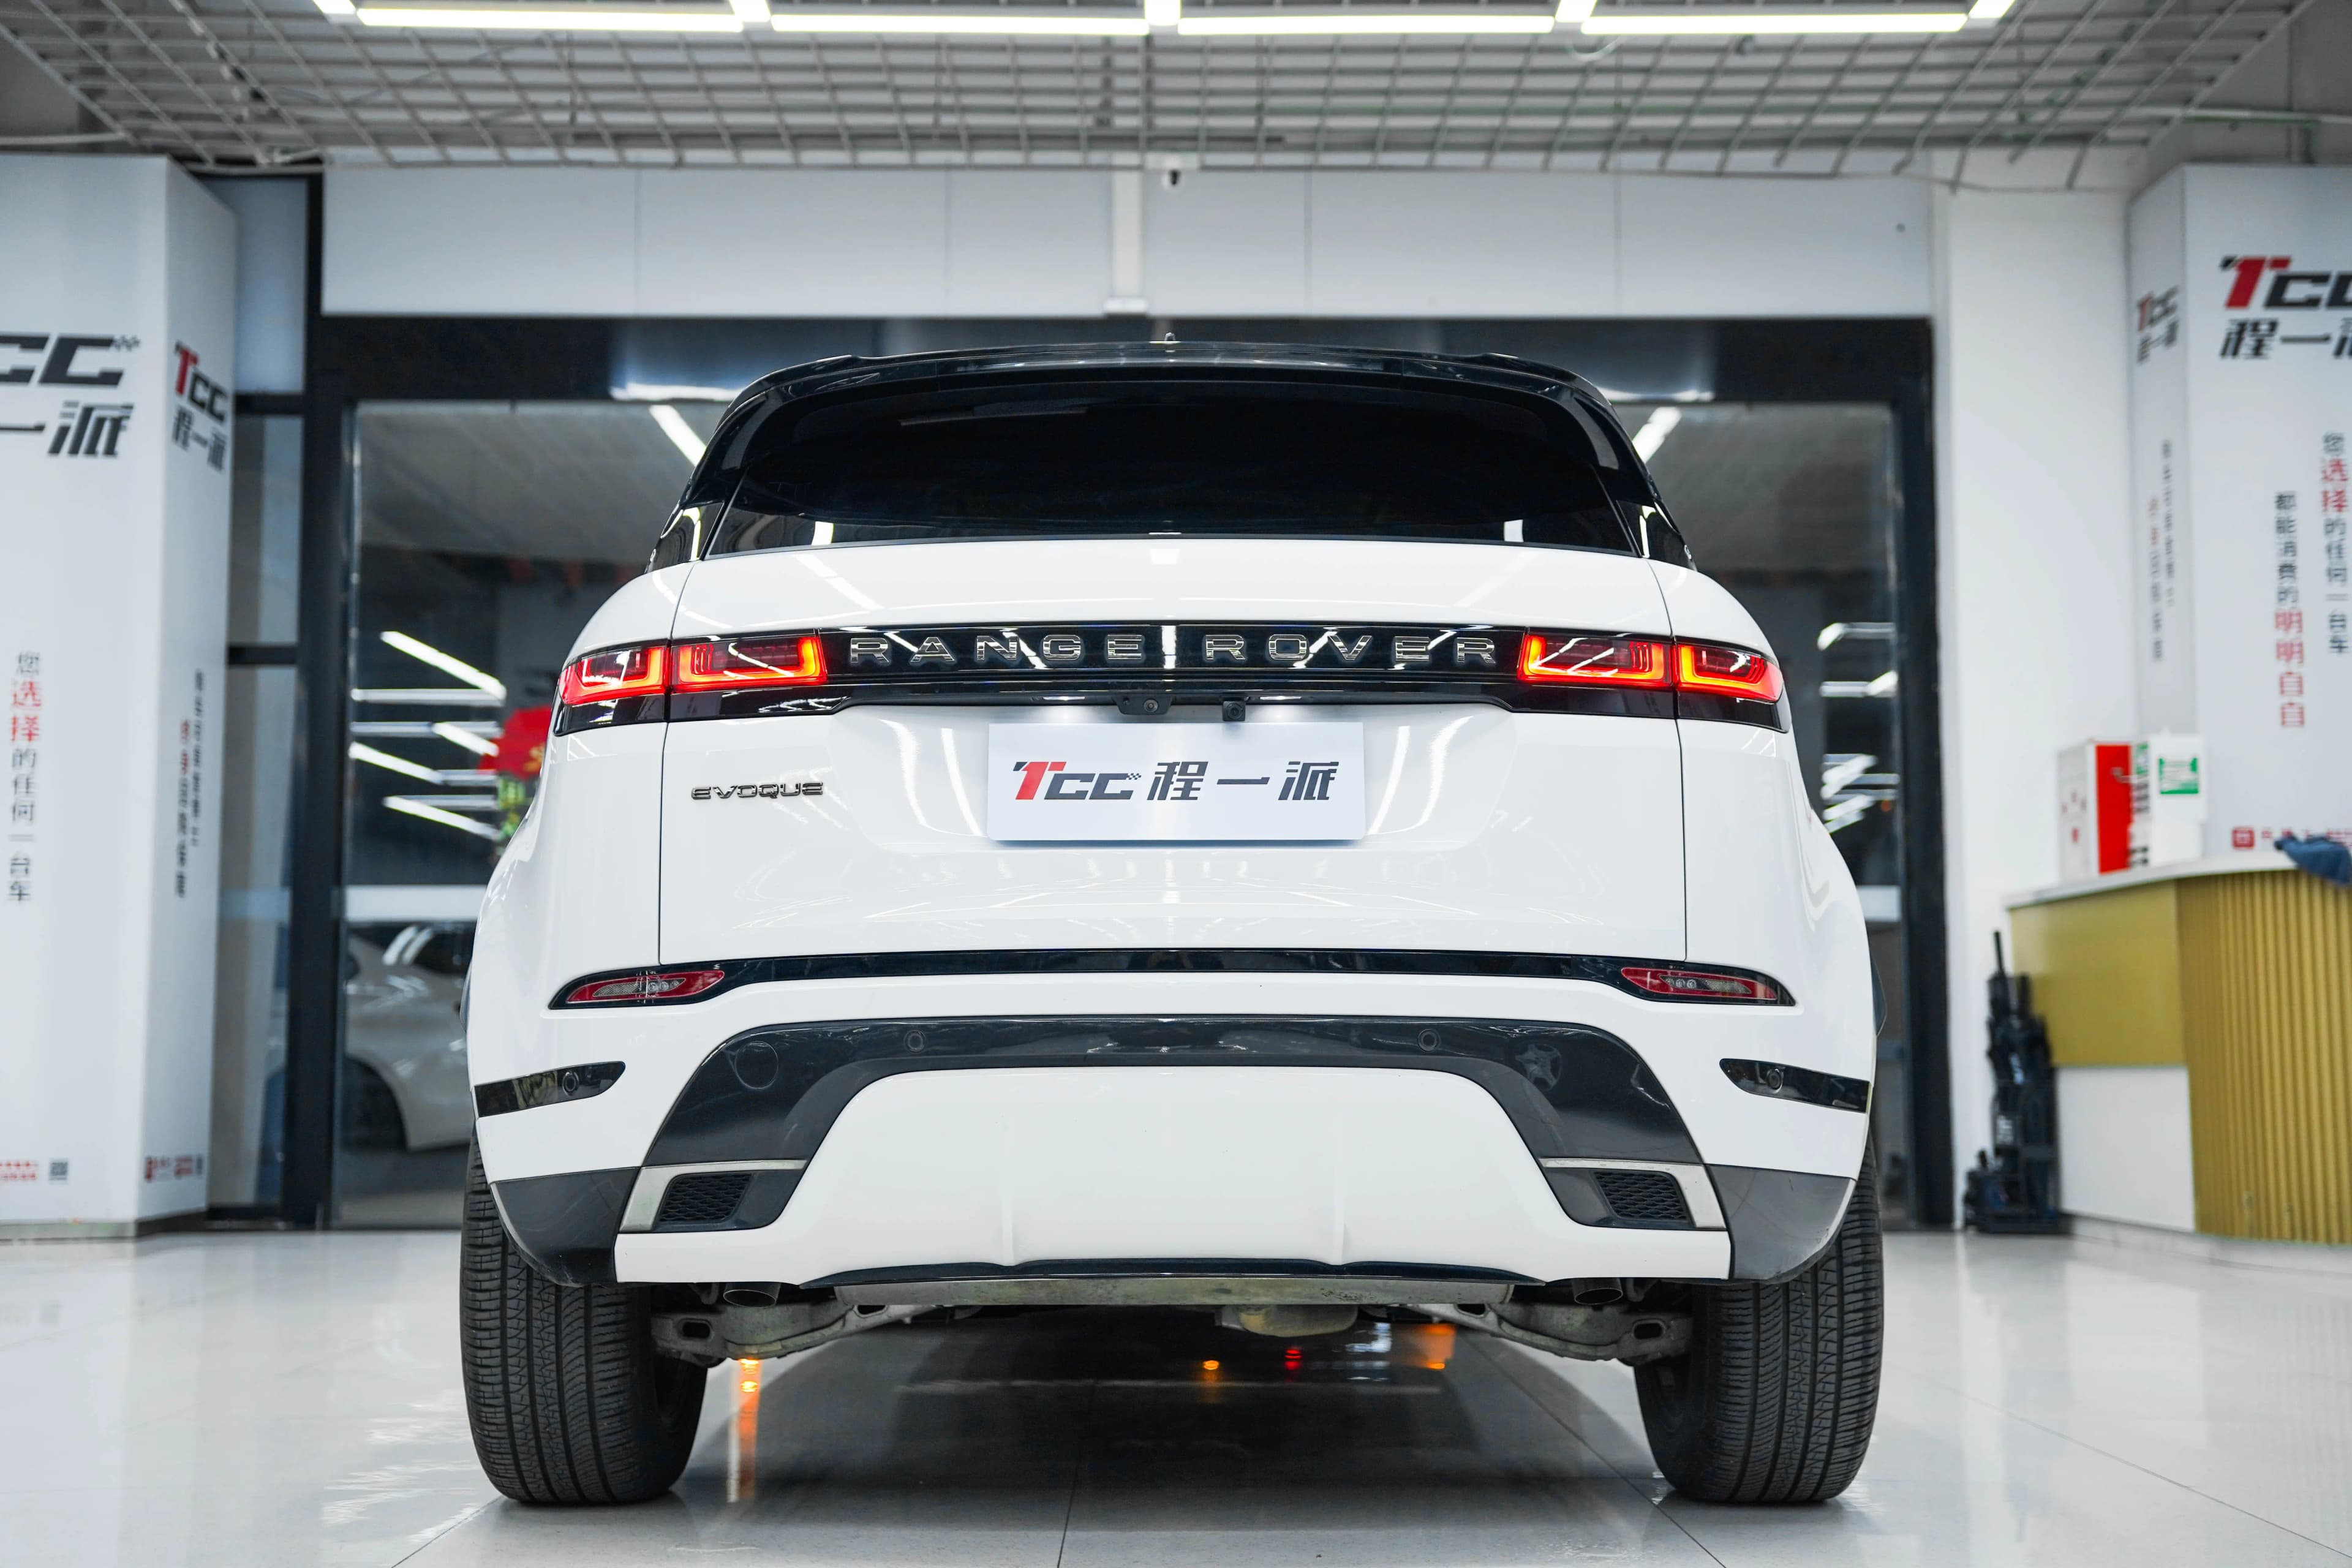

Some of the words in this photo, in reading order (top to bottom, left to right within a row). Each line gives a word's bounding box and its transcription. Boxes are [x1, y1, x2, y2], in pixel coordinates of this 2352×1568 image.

[2220, 317, 2352, 360] 程一
[850, 634, 1142, 663] RANGE
[1205, 634, 1496, 664] ROVER
[691, 782, 824, 800] EVOQUE
[1147, 761, 1340, 801] 程一派
